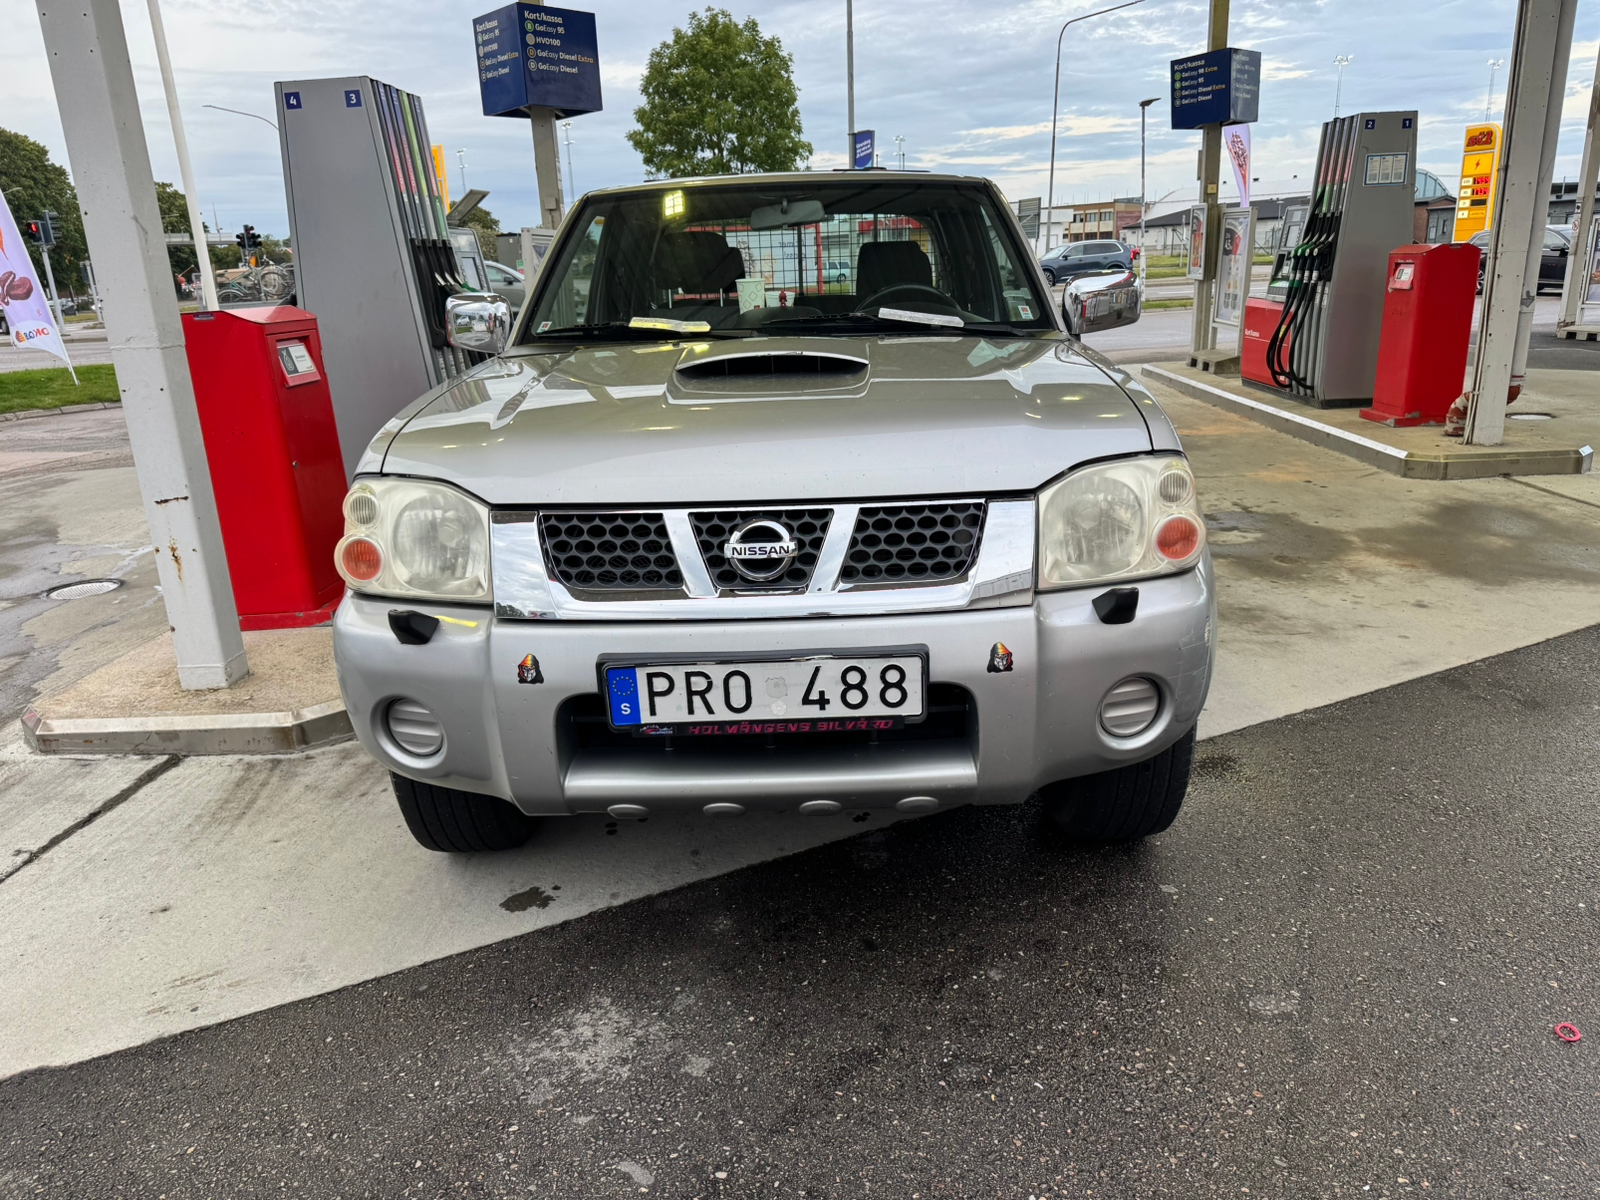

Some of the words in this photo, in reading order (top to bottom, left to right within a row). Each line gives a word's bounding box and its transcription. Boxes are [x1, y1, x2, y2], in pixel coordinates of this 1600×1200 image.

[524, 10, 563, 24] Kort/kassa
[535, 23, 556, 34] GoEasy
[557, 26, 565, 34] 95
[536, 36, 561, 46] HVO100
[537, 49, 558, 60] GoEasy
[559, 52, 578, 61] Diesel
[578, 55, 594, 63] Extra
[538, 62, 560, 73] GoEasy
[560, 65, 578, 74] Diesel
[289, 95, 297, 105] 4
[349, 93, 357, 104] 3
[731, 545, 790, 556] NISSAN
[620, 702, 631, 715] S
[645, 669, 753, 716] PRO
[801, 663, 909, 711] 488
[689, 721, 811, 735] HOLMÄNGENS
